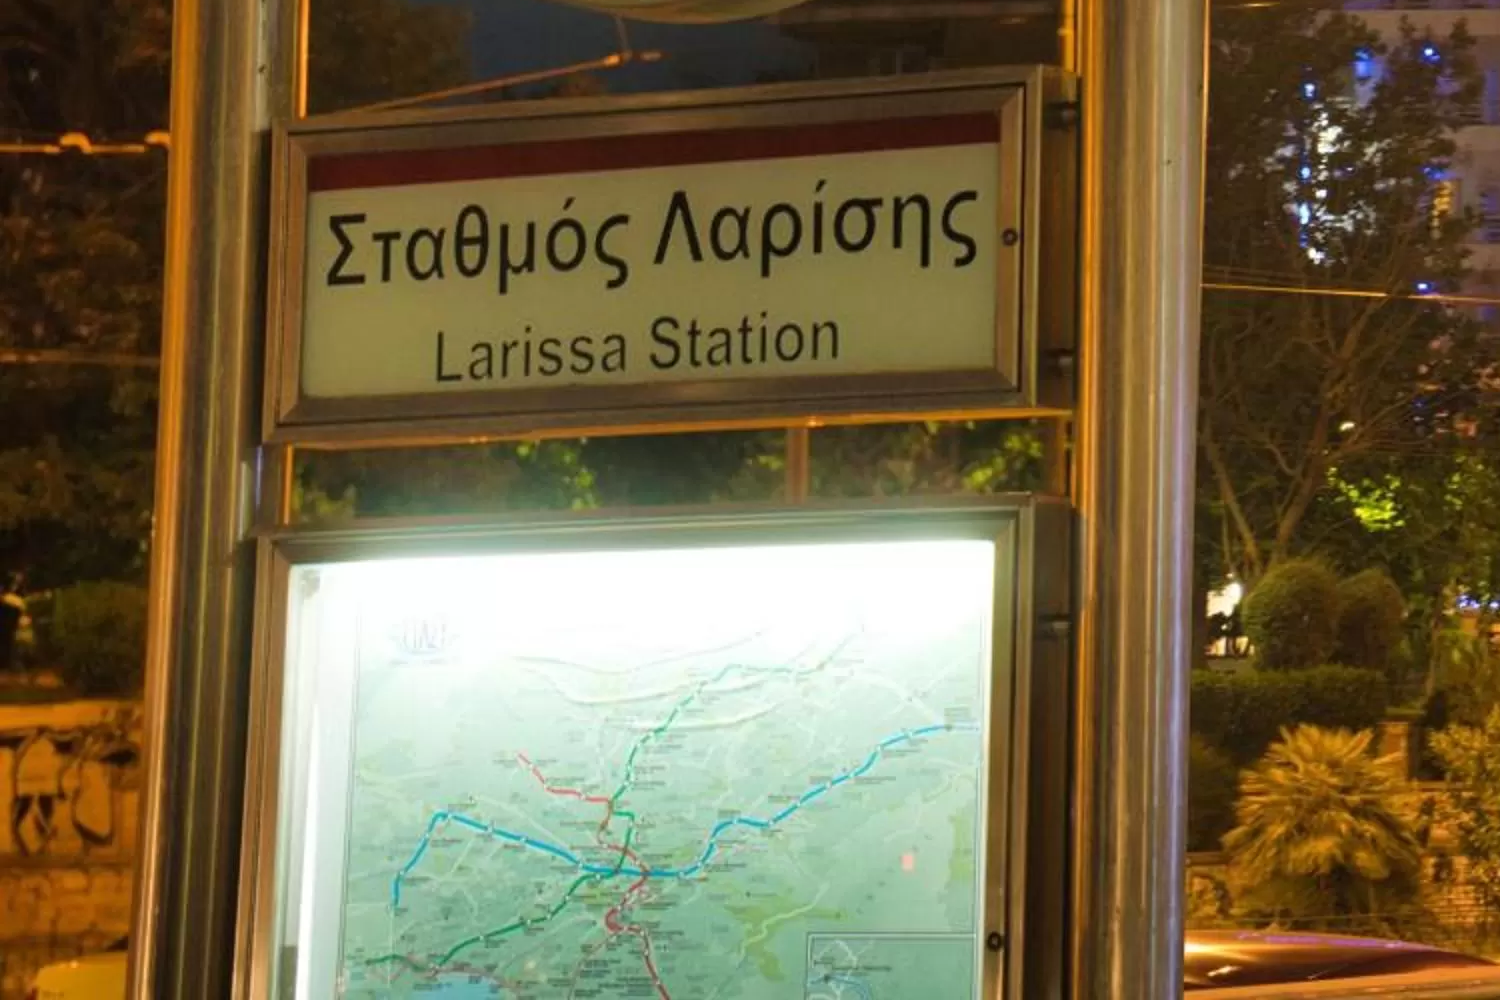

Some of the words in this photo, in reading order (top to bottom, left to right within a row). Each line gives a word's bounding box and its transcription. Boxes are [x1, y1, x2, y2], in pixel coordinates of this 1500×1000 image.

[325, 196, 631, 296] Σταθμός
[653, 179, 980, 280] Λαρίσης
[435, 324, 627, 384] Larissa
[648, 311, 840, 371] Station
